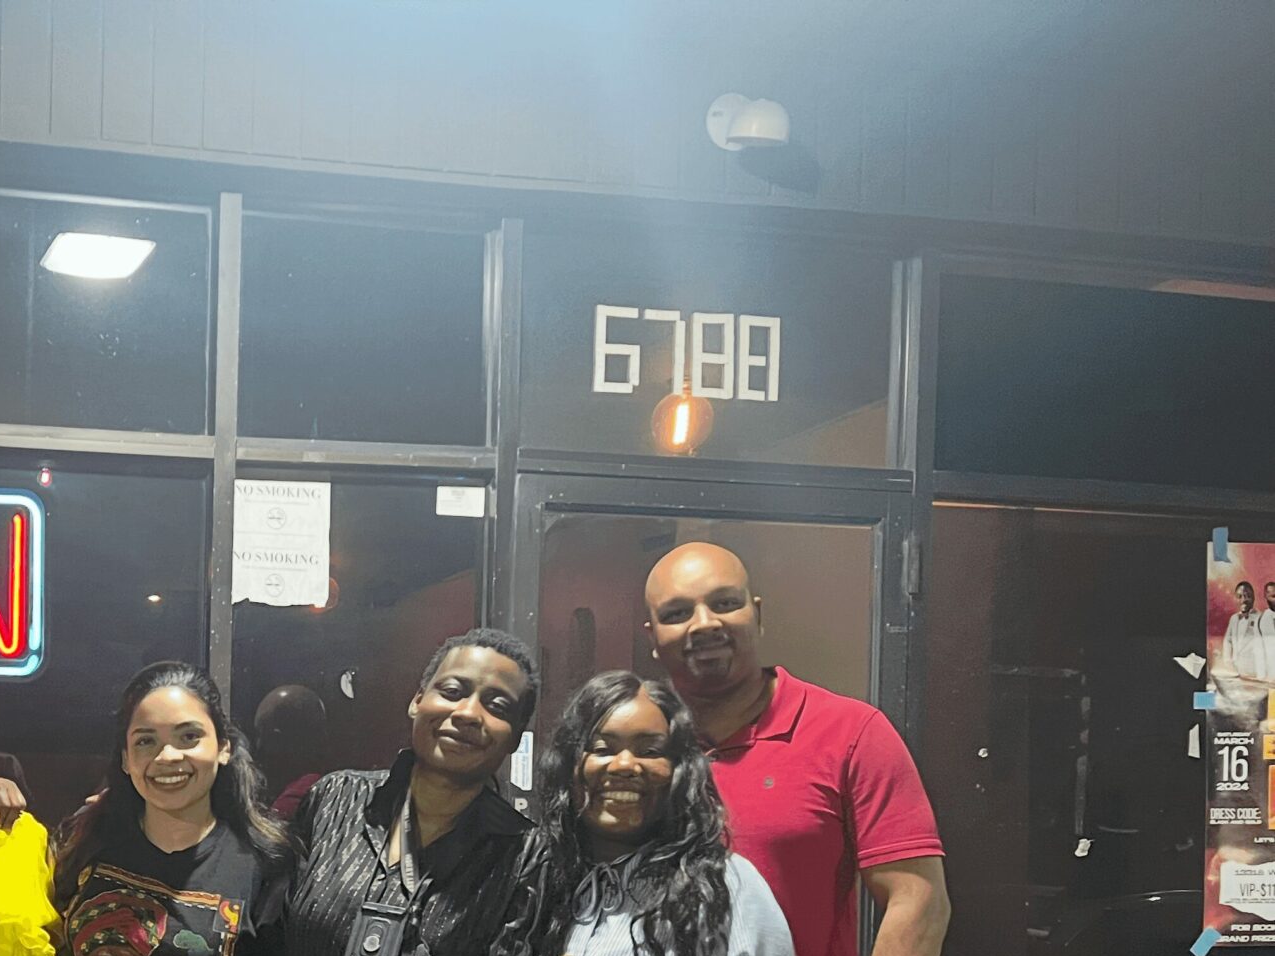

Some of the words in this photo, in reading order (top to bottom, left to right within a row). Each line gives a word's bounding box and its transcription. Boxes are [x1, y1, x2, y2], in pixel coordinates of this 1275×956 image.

[593, 304, 781, 401] 6788
[235, 484, 254, 497] NO
[256, 486, 322, 499] SMOKING
[233, 551, 252, 561] NO
[255, 552, 320, 566] SMOKING
[1213, 737, 1255, 746] MARCH
[1217, 745, 1249, 782] 16
[1216, 782, 1250, 792] 2024
[1209, 807, 1236, 820] DRESS
[1231, 924, 1251, 932] FOR
[1252, 924, 1275, 932] BOO
